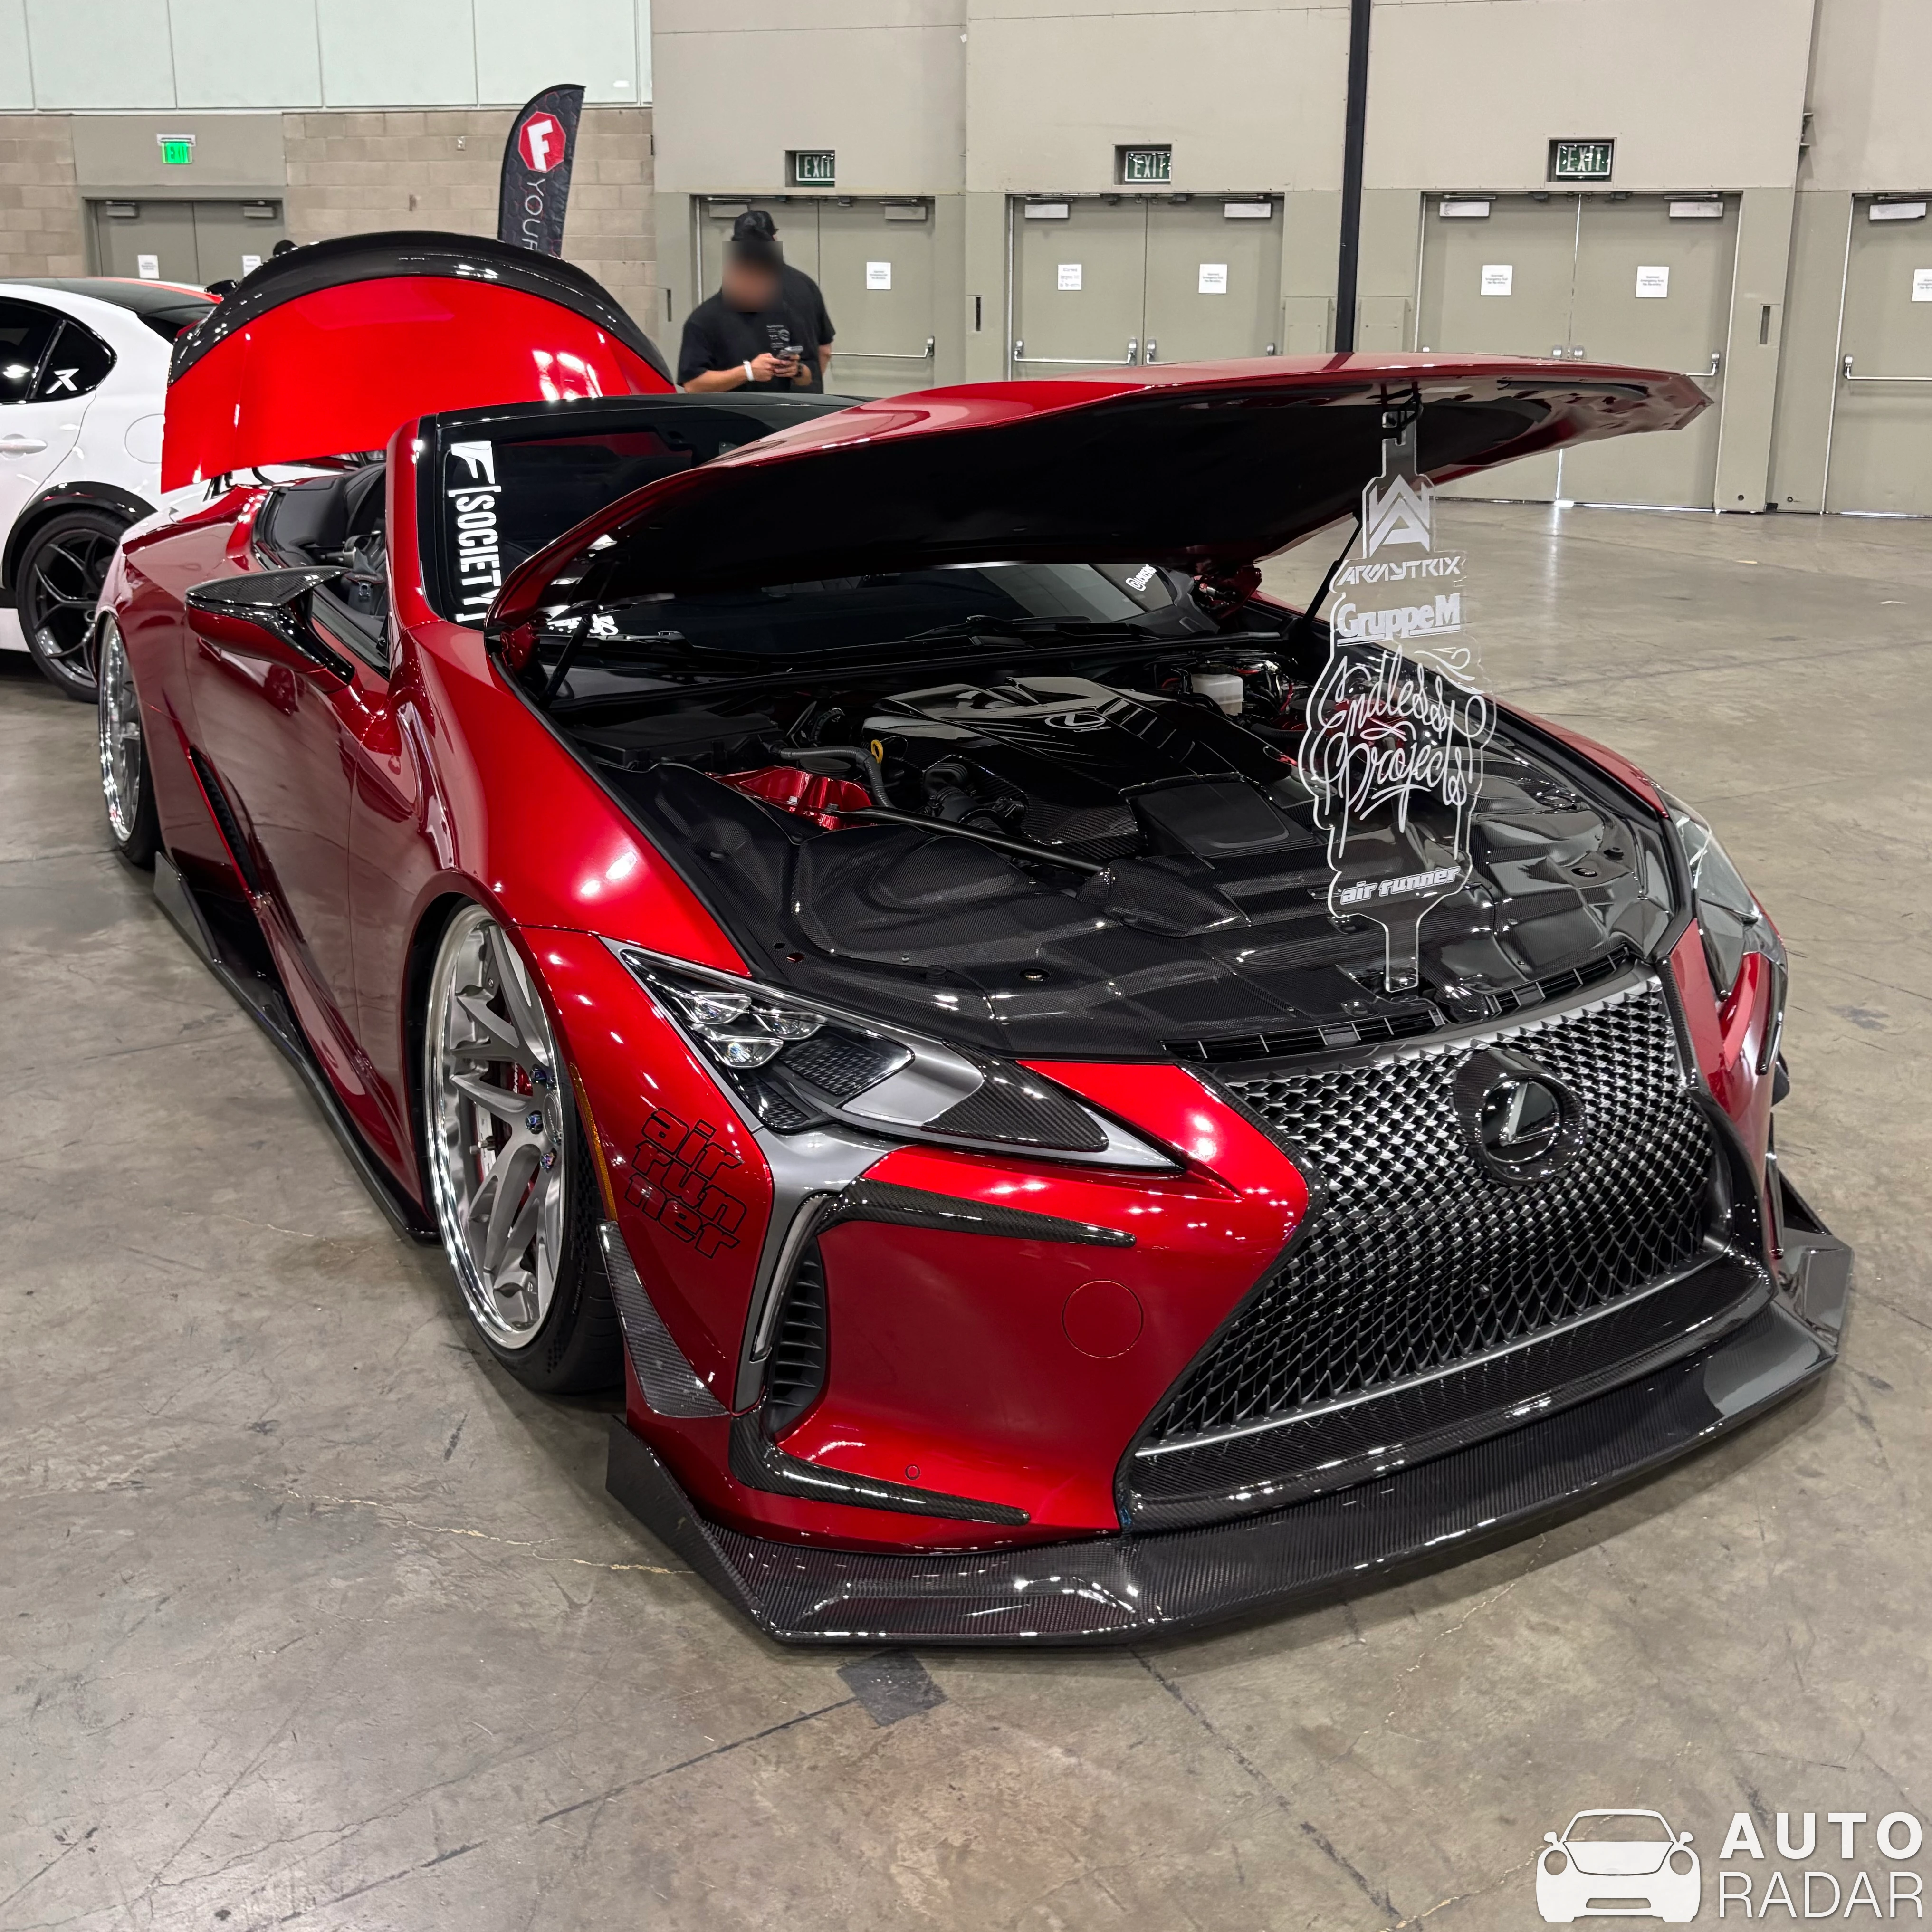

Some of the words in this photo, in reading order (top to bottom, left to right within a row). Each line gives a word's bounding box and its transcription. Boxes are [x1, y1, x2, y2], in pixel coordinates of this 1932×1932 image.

[804, 156, 832, 177] EXIT
[1134, 154, 1166, 177] EXIT
[1567, 147, 1604, 171] EXIT
[1336, 556, 1461, 586] ARMYTRIX
[1337, 593, 1461, 641] GruppeM
[1318, 645, 1448, 739] Endless
[1340, 881, 1378, 905] air
[1378, 866, 1461, 897] runner
[641, 1107, 745, 1180] air
[631, 1139, 747, 1234] run
[624, 1173, 741, 1259] ner
